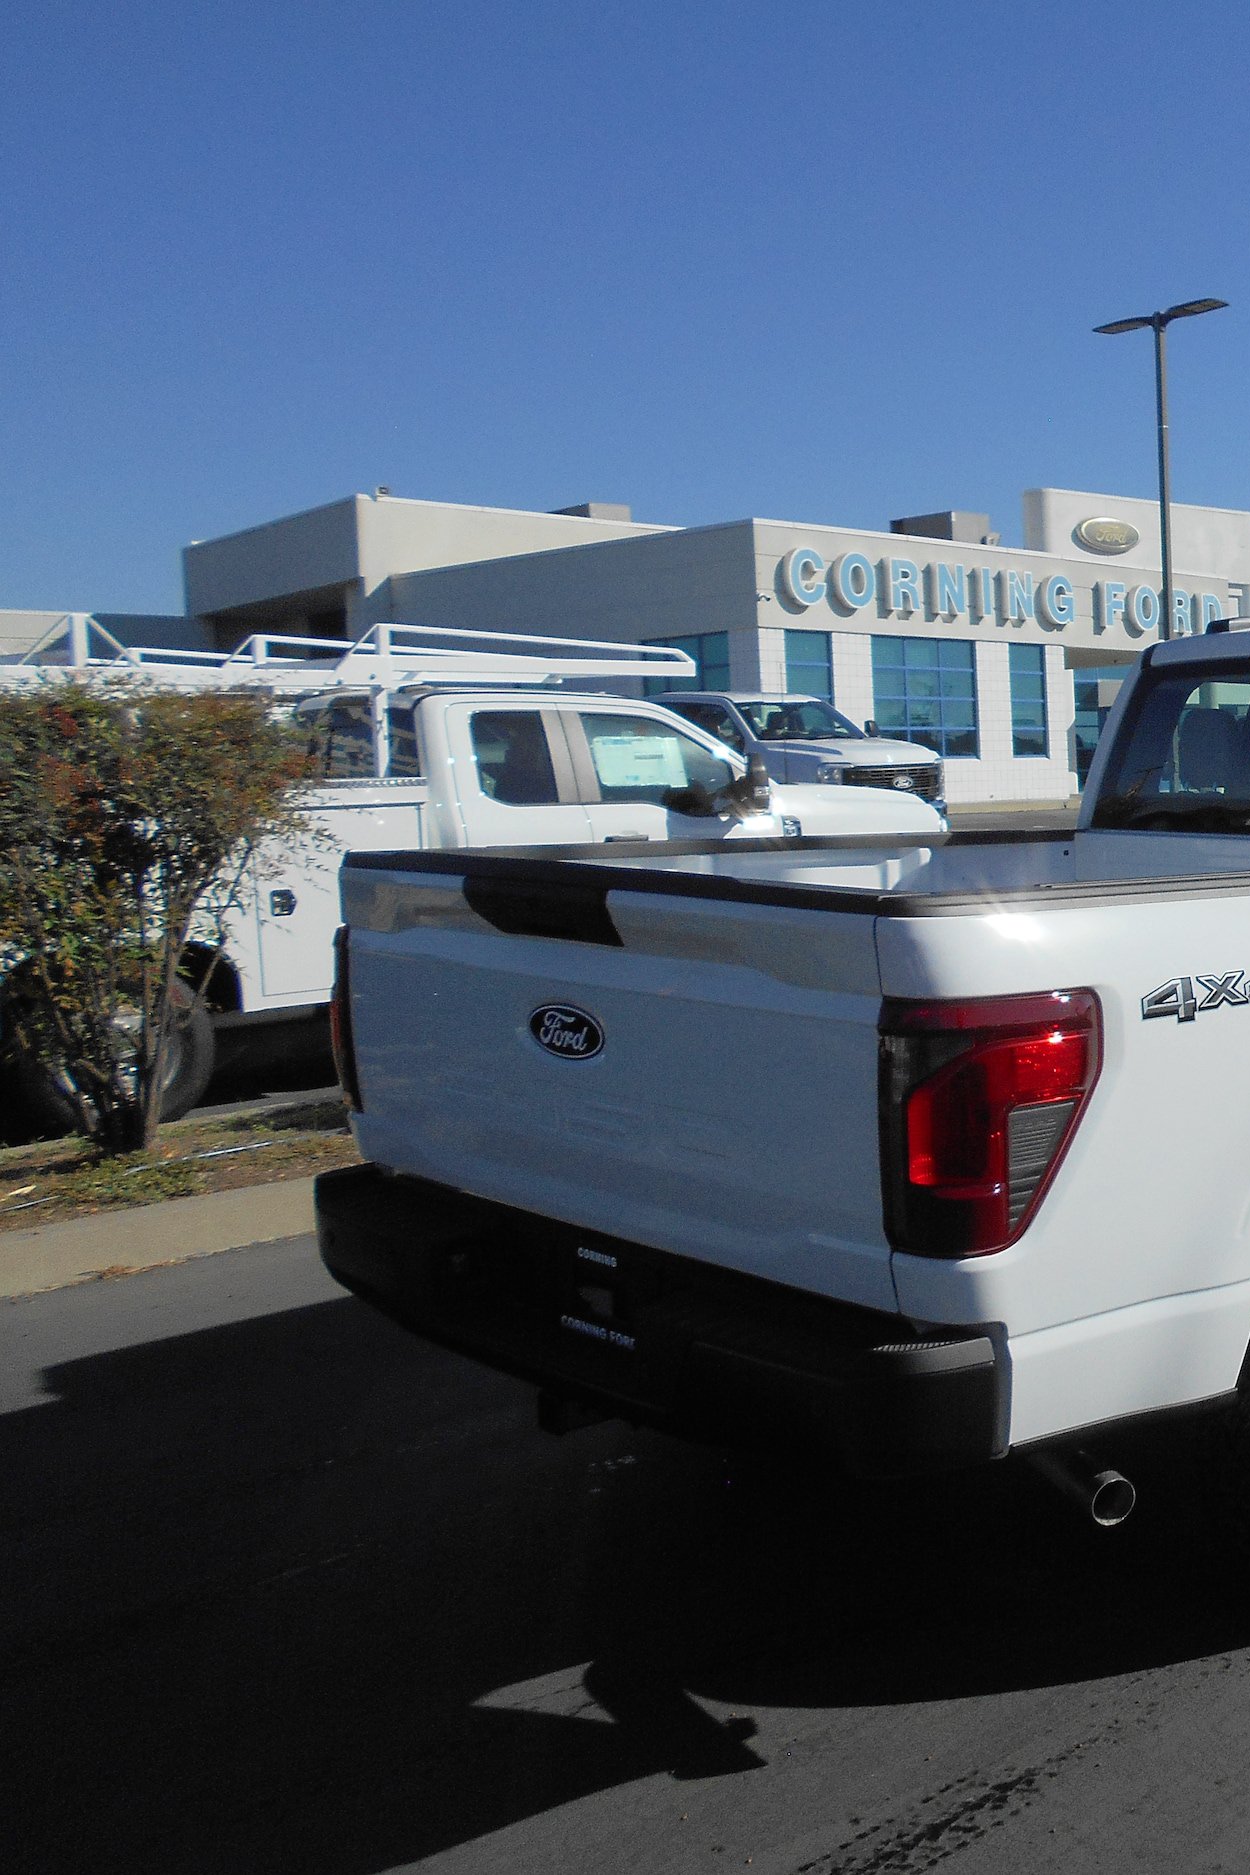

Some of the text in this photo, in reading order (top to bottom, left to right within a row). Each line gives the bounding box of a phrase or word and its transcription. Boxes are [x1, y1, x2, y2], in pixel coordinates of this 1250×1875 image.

[1096, 524, 1128, 545] Ford
[787, 547, 1224, 634] CORNING FORD
[540, 1010, 589, 1051] Ford
[577, 1247, 617, 1268] CORNING
[560, 1314, 607, 1340] CORNING
